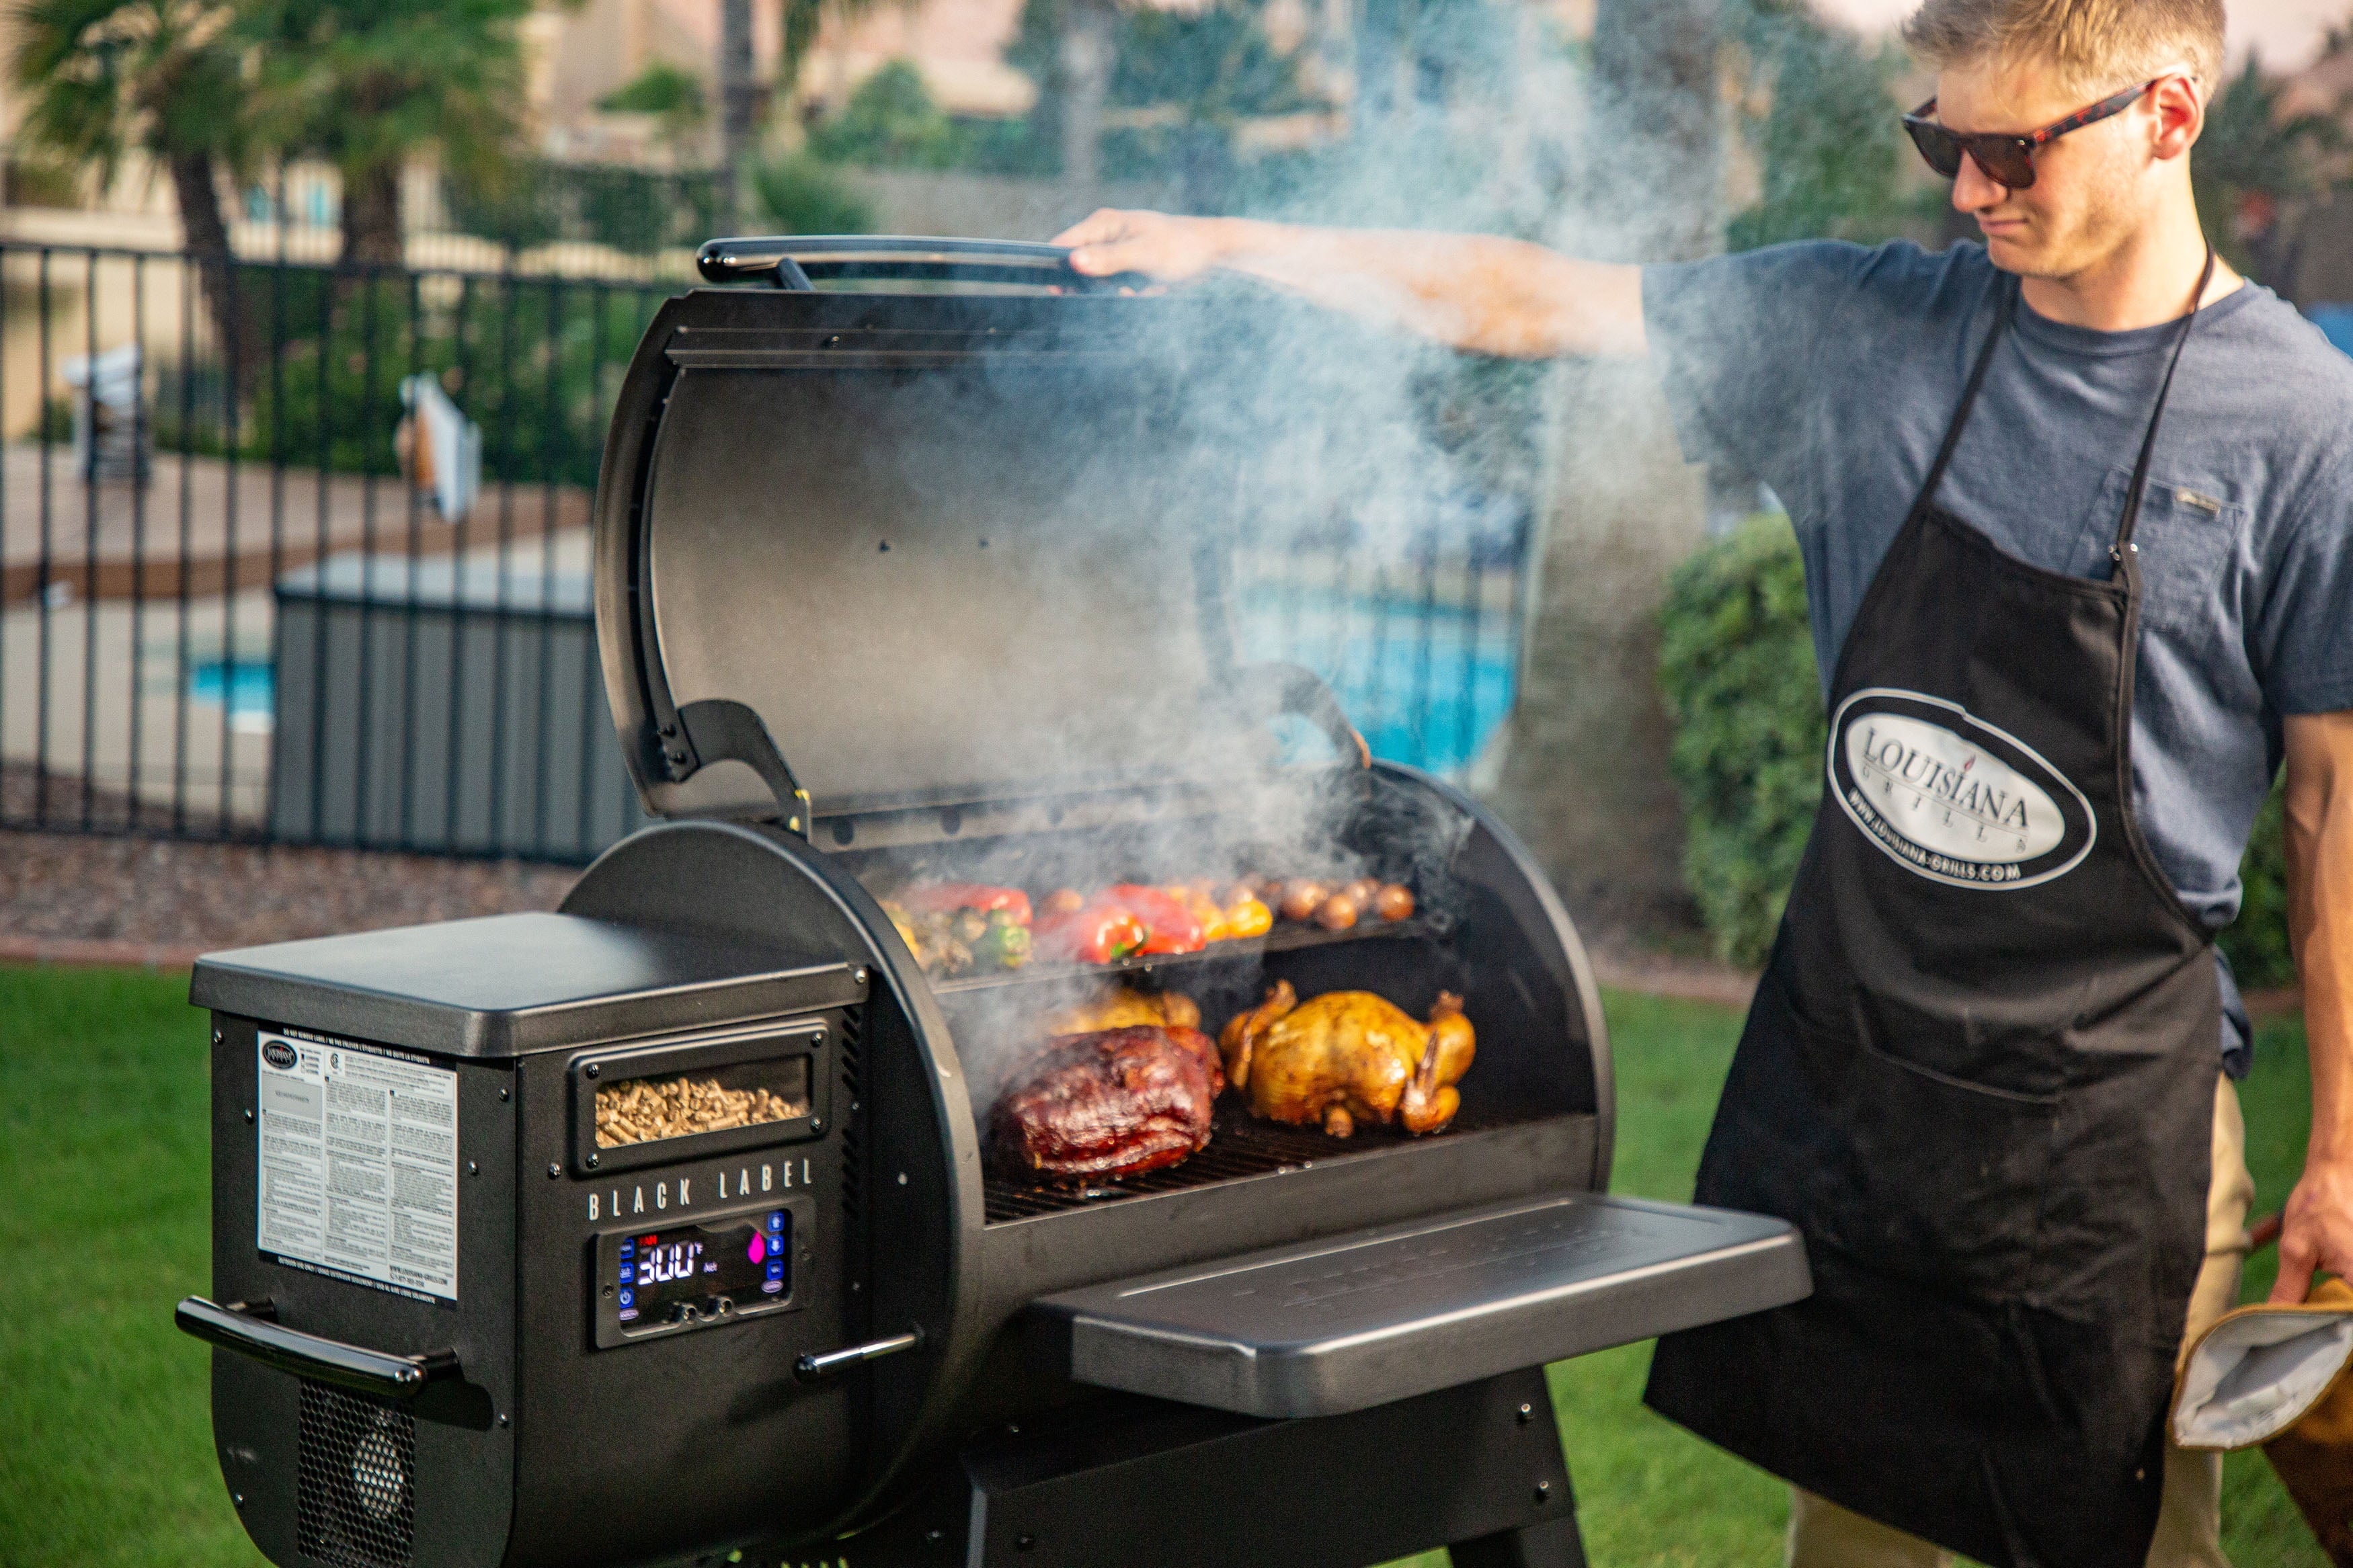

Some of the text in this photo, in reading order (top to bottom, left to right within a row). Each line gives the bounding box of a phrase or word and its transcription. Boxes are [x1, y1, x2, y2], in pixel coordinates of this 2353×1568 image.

[1863, 765, 2026, 854] GRILLS
[1864, 727, 2029, 827] LOUISIANA
[1849, 786, 2021, 881] WWW.LOUISIANA-GRILLS.COM
[588, 1158, 811, 1221] BLACK LABEL
